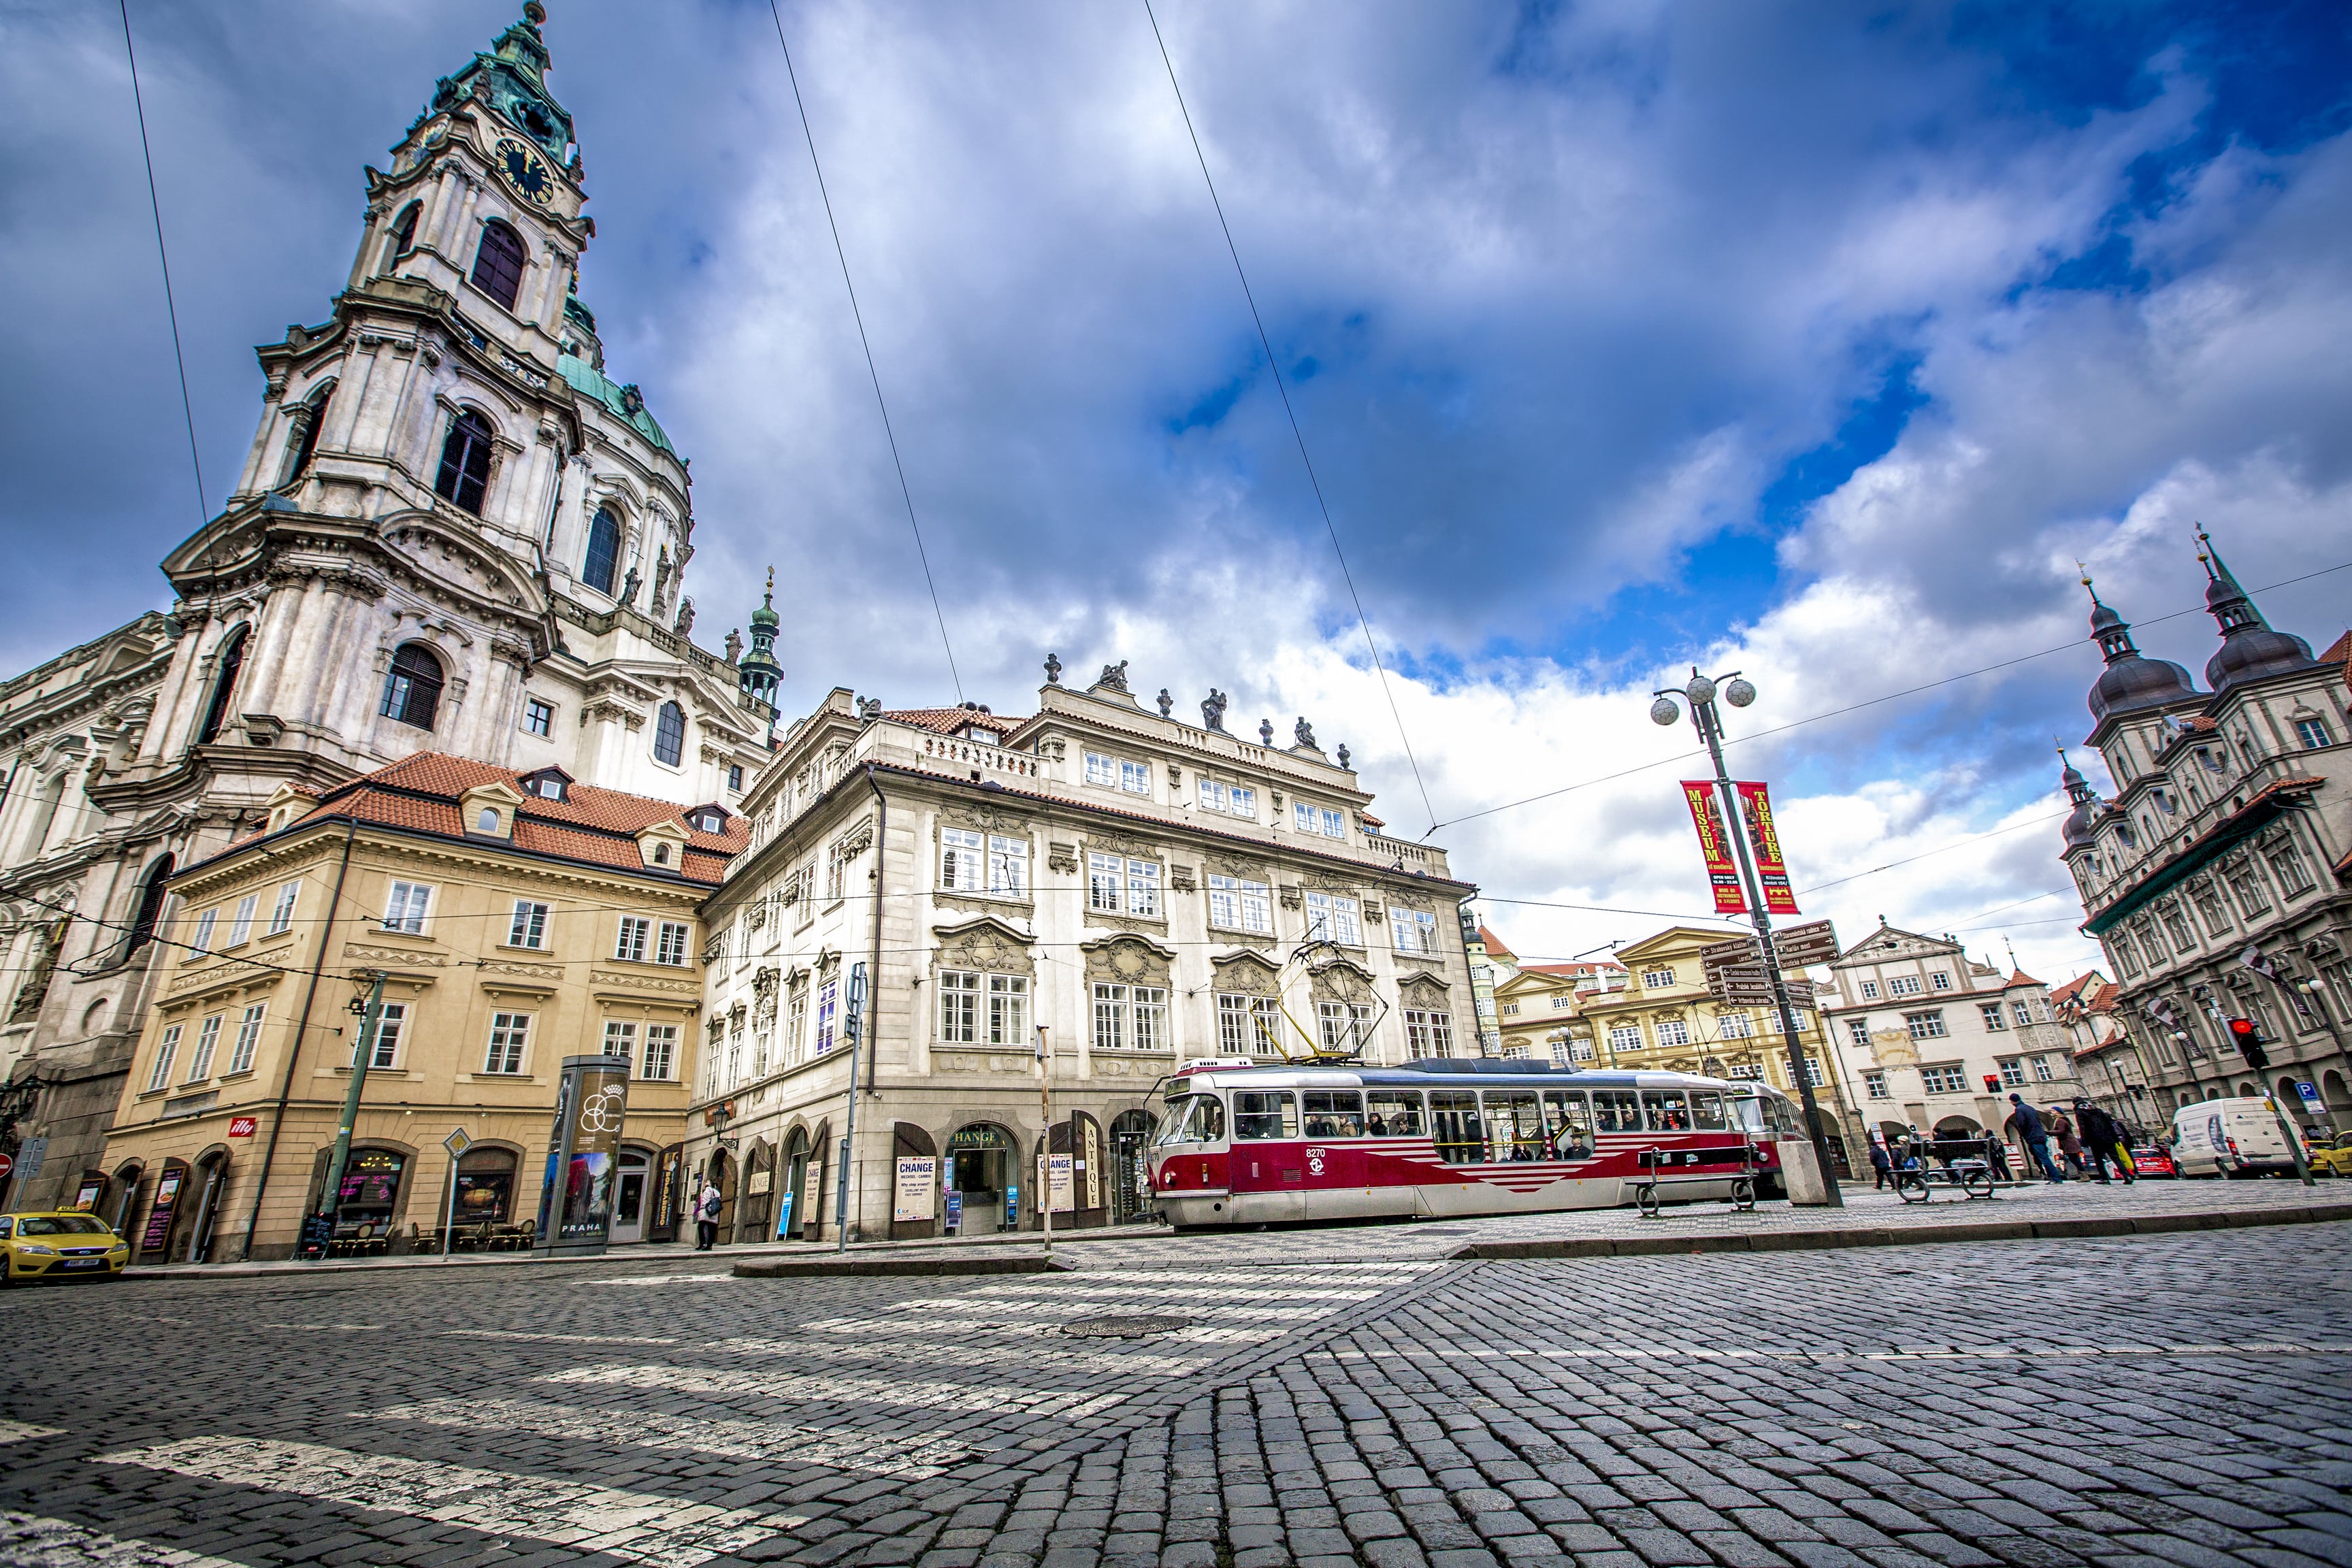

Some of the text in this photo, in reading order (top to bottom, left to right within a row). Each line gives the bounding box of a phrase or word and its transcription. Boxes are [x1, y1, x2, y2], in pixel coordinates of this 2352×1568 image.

[1687, 790, 1720, 862] MUSEUM
[1754, 791, 1782, 862] TORTURE
[1710, 941, 1748, 953] Strahovský klášter
[1801, 956, 1821, 964] informace
[231, 1120, 254, 1137] illy
[1306, 1149, 1326, 1158] 8270
[900, 1163, 933, 1173] CHANGE
[1040, 1160, 1071, 1169] CANGE
[1088, 1129, 1096, 1204] ANTIQUE
[561, 1224, 600, 1232] PRAHA
